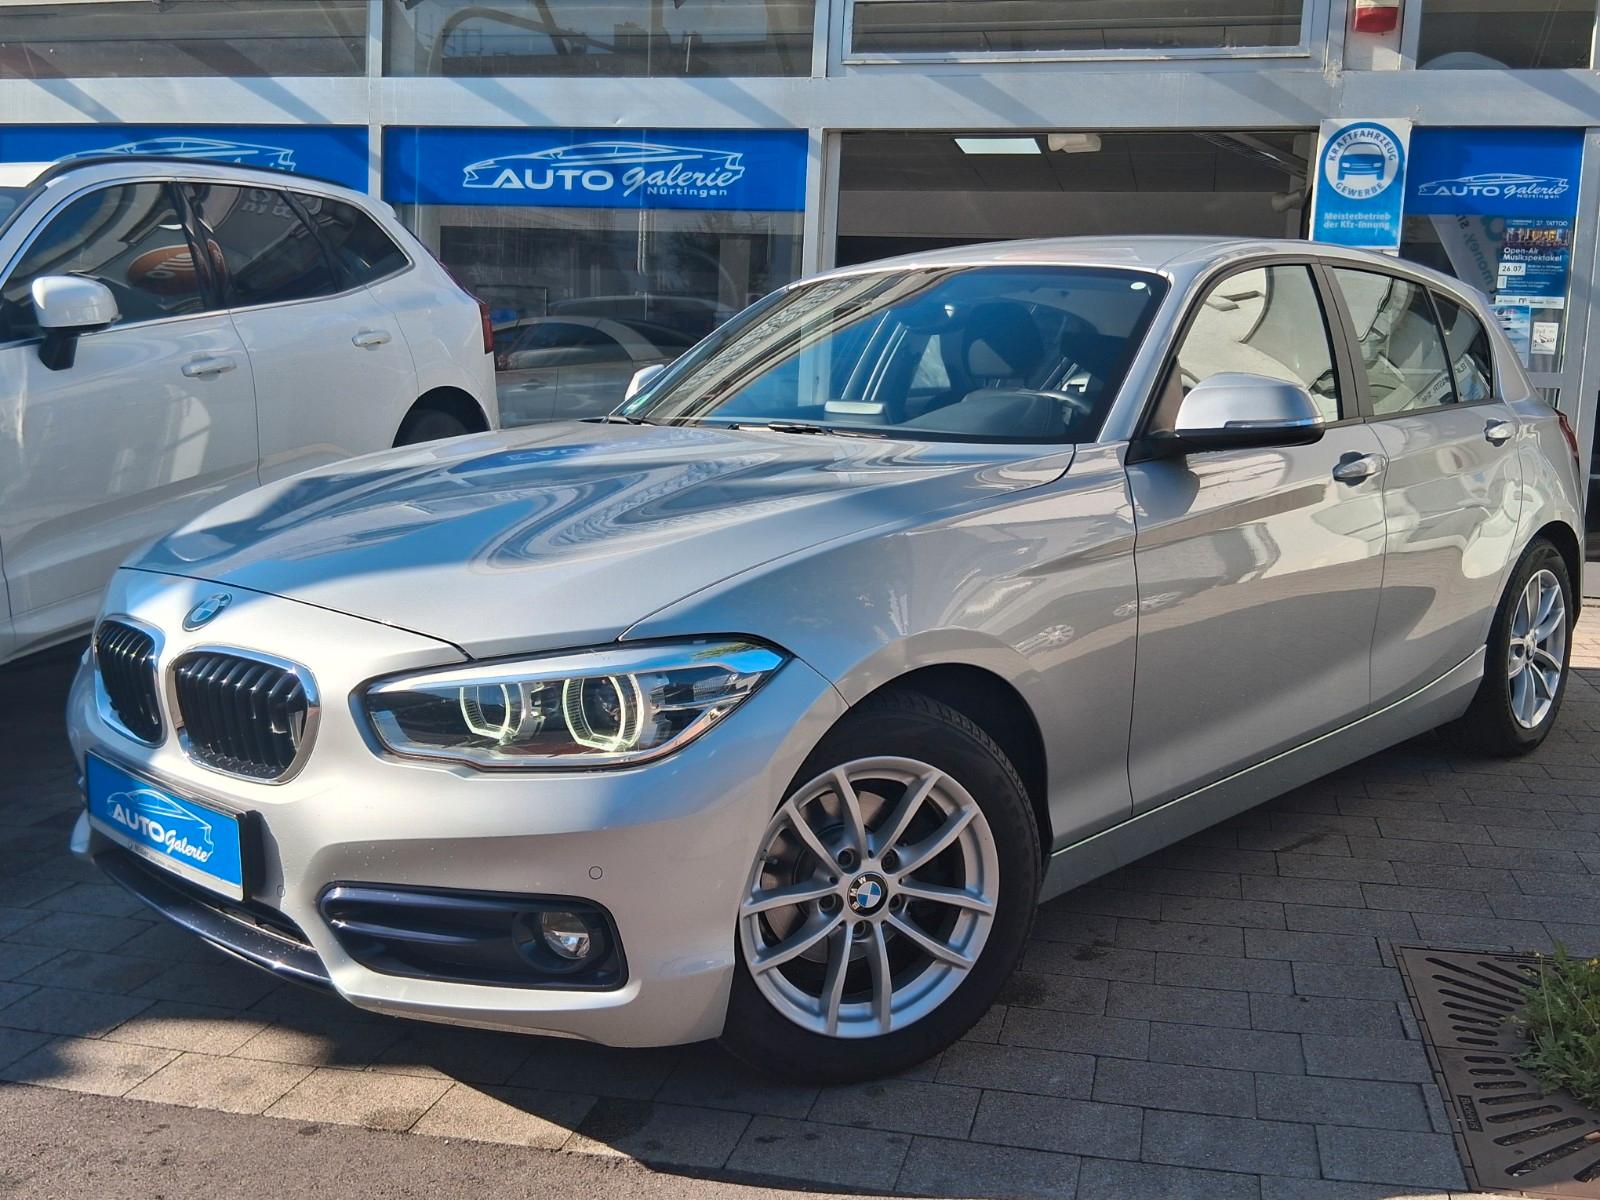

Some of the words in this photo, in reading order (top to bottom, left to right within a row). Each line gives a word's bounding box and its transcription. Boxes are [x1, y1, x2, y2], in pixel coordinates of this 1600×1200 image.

[1328, 130, 1398, 161] KRAFTFAHRZEUG
[492, 168, 614, 191] AUTO
[622, 162, 738, 198] galerie
[647, 186, 727, 198] Nürtingen
[1335, 182, 1384, 197] GEWERBE
[1433, 186, 1500, 196] AUTO
[1503, 183, 1564, 199] galerie
[1323, 212, 1391, 221] Meisterbetrieb
[1340, 221, 1389, 230] Kfz-Innung
[1503, 247, 1539, 255] Open-Air
[1503, 254, 1562, 262] Musikspektakel
[1502, 265, 1524, 273] 26.07.
[112, 804, 165, 843] AUTO
[165, 829, 212, 863] Galerie
